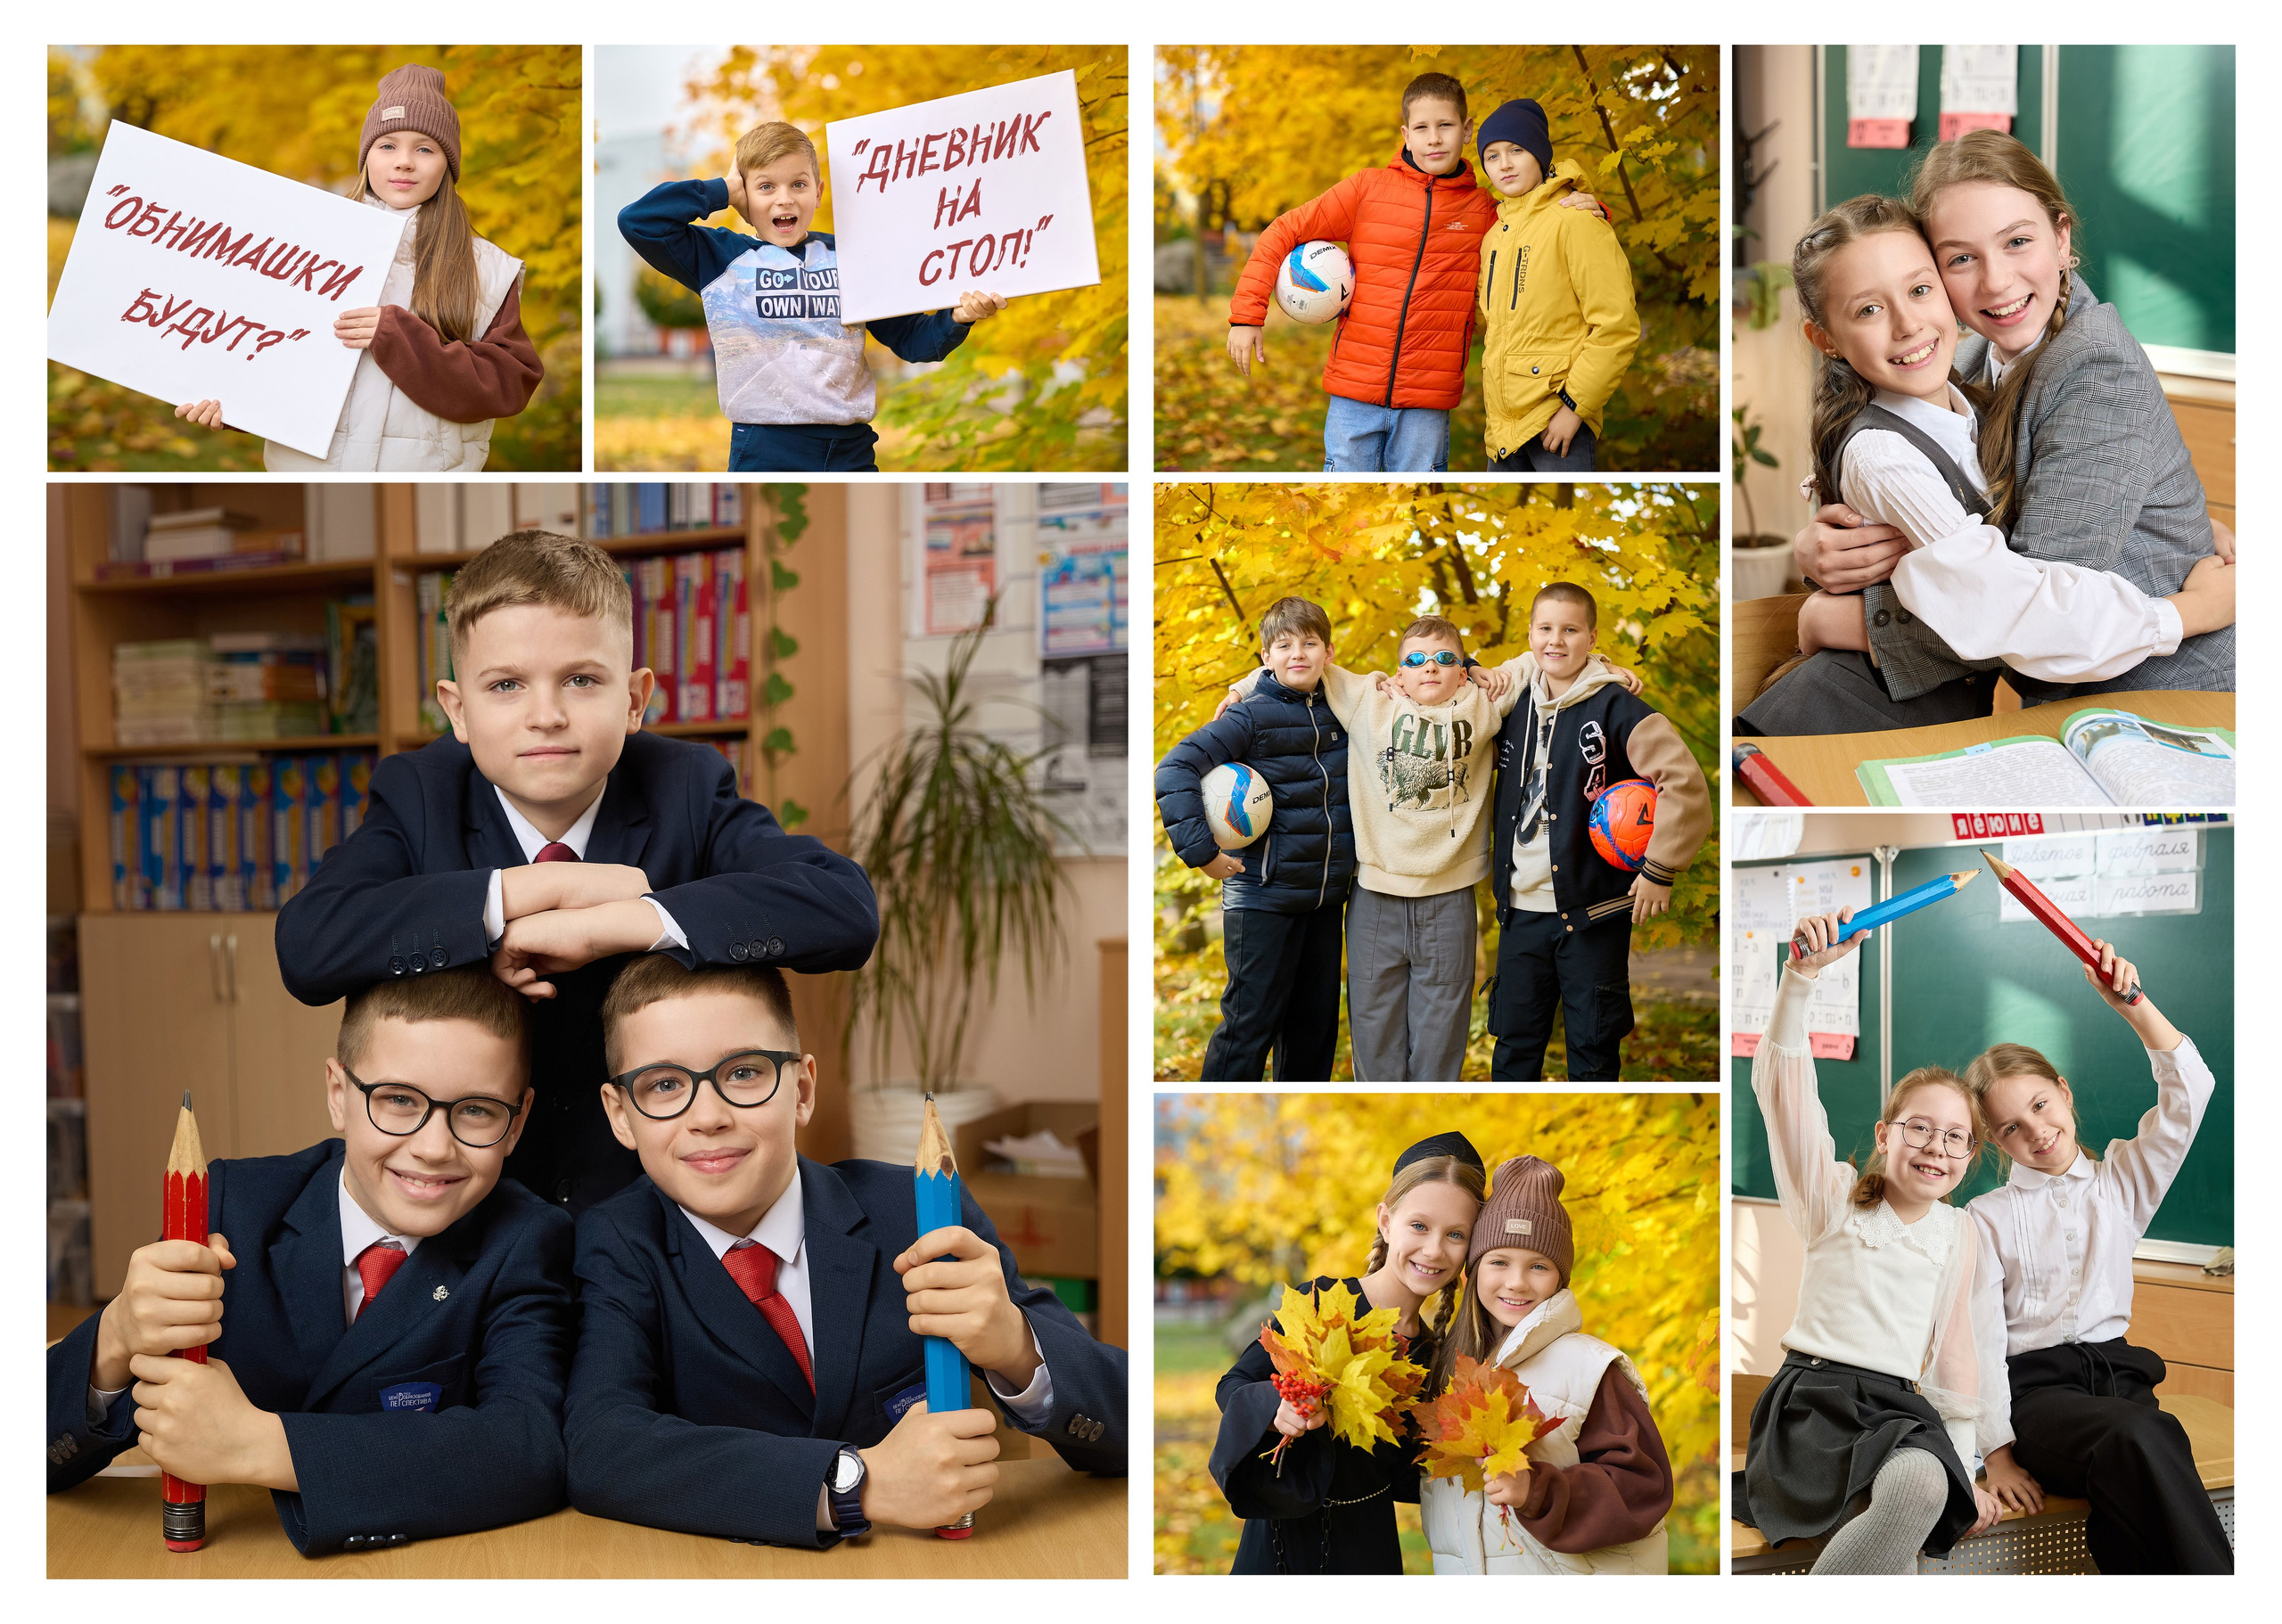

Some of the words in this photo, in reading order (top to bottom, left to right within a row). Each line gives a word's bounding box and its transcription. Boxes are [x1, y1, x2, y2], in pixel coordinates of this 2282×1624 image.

[852, 111, 1051, 193] "ДНЕВНИК
[934, 178, 981, 229] НА
[105, 185, 363, 300] "ОБНИМАШКИ
[919, 214, 1053, 285] СТОЛ!"
[1309, 245, 1337, 259] DEMIX
[759, 270, 784, 288] GO
[121, 288, 310, 360] БУДУТ?"
[761, 297, 801, 316] OWN
[2008, 842, 2084, 863] Девятое
[2108, 837, 2190, 872] февраля
[2107, 877, 2189, 912] работа
